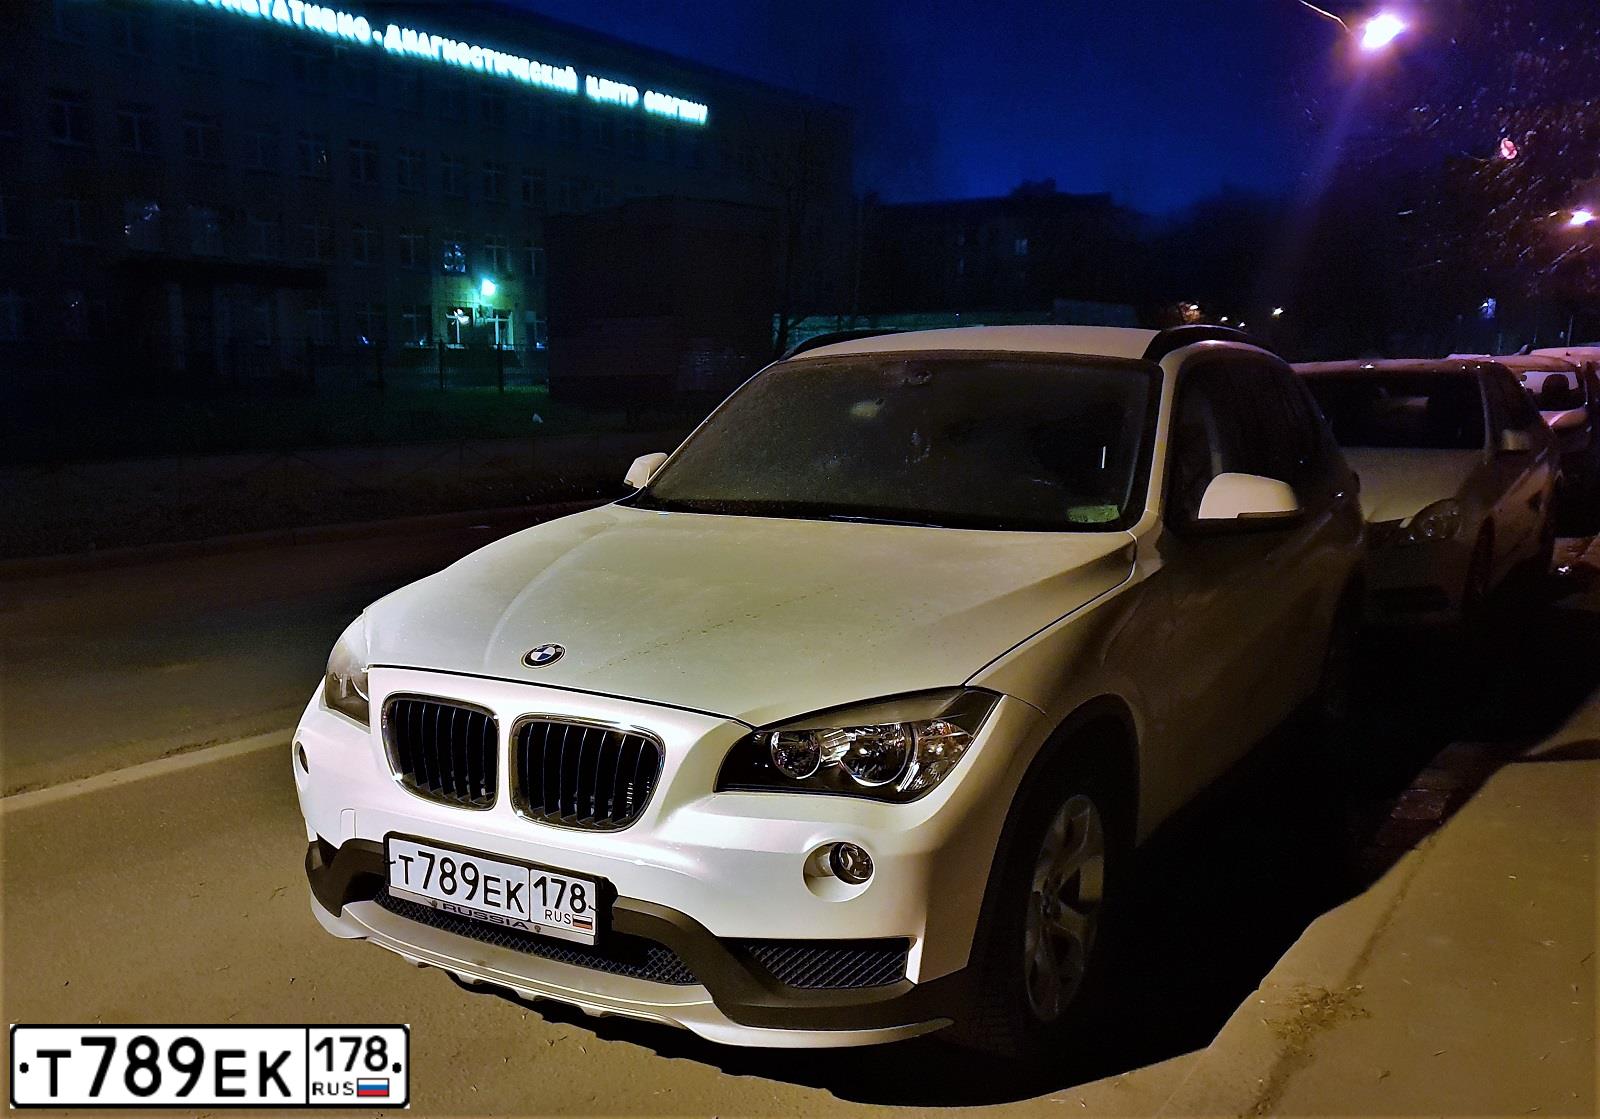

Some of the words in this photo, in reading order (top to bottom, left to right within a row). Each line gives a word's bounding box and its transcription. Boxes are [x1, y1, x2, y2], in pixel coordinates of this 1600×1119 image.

[533, 875, 587, 914] 178
[442, 902, 529, 930] RUSSIA
[544, 909, 572, 925] RUS
